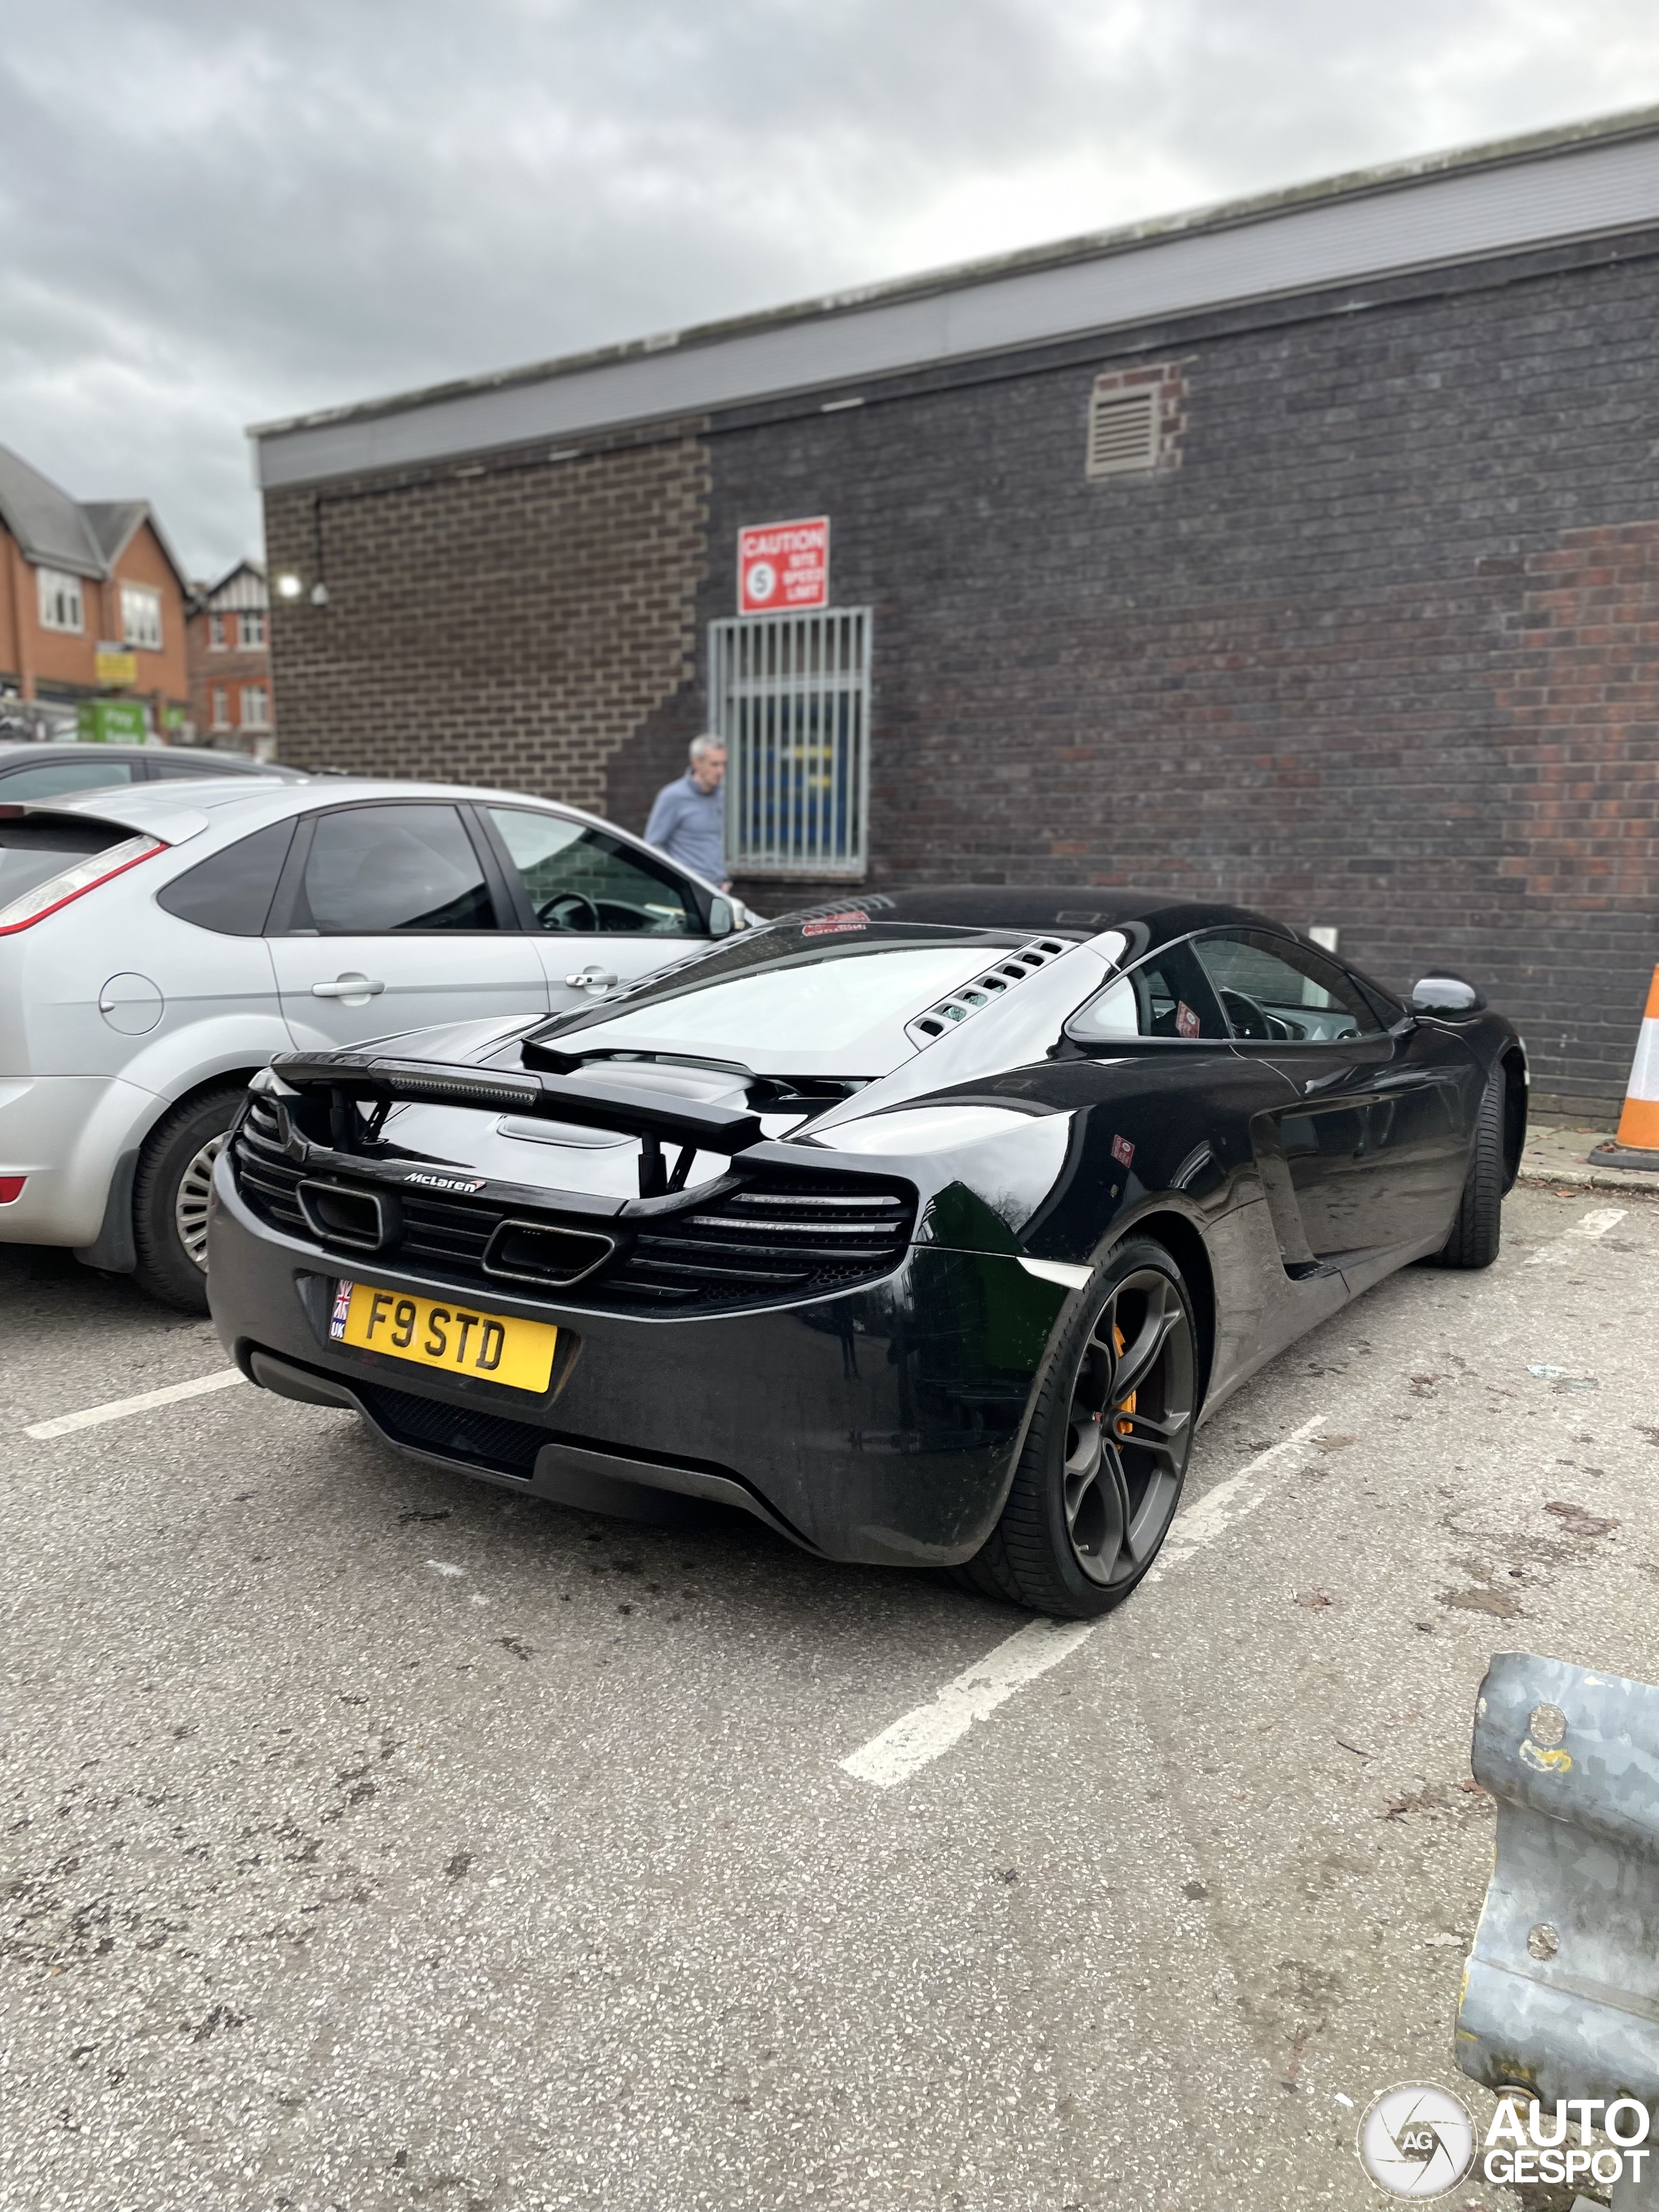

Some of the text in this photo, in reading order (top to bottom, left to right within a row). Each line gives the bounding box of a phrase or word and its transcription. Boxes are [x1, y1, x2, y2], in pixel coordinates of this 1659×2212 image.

[743, 529, 824, 557] CAUTION
[404, 1172, 476, 1193] McLaren
[331, 1320, 345, 1339] UK
[365, 1292, 505, 1371] F9 STD
